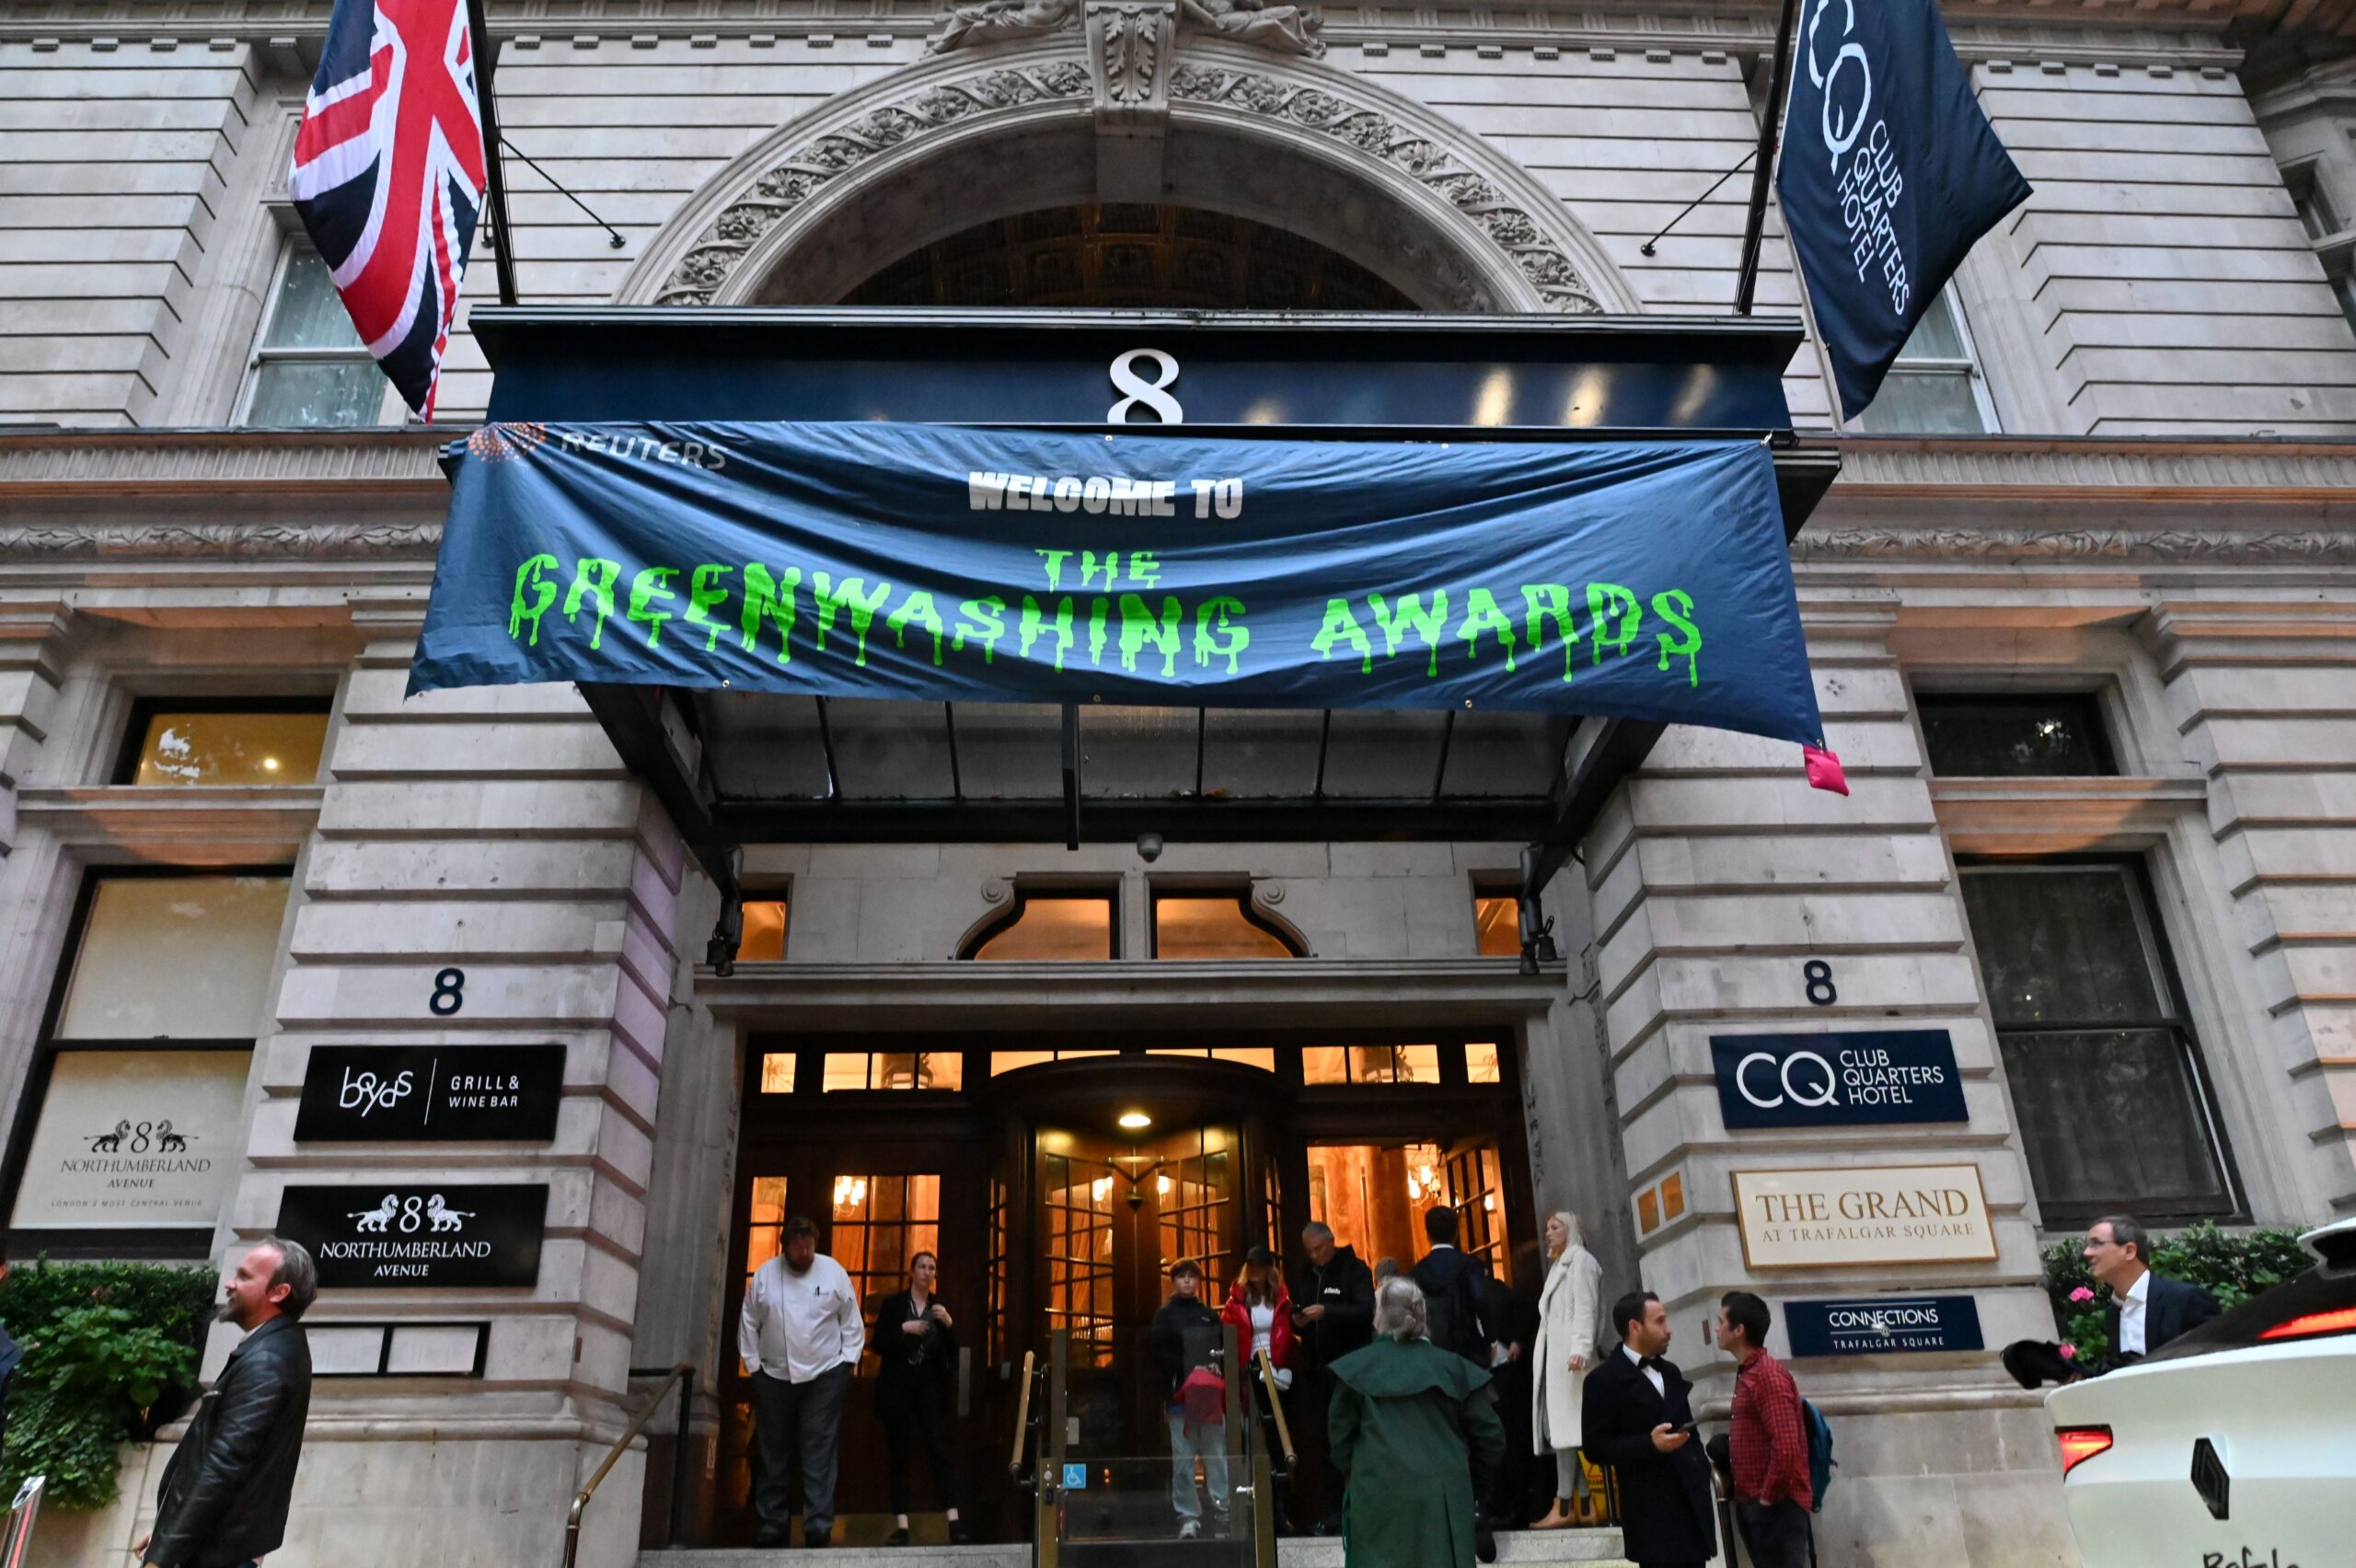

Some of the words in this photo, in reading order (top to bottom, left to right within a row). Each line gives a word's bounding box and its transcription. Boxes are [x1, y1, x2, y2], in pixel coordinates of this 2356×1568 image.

[1869, 120, 1903, 208] CLUB
[1838, 168, 1875, 282] HOTEL
[1854, 147, 1910, 316] QUARTERS
[1107, 348, 1183, 423] 8
[560, 432, 728, 469] REUTERS
[968, 472, 1175, 516] WELCOME
[1191, 478, 1242, 519] TO
[1034, 549, 1161, 594] THE
[509, 554, 1250, 678] GREENWASHING
[1311, 582, 1702, 687] AWARDS
[429, 968, 465, 1015] 8
[1803, 960, 1837, 1006] 8
[1840, 1049, 1889, 1067] CLUB
[340, 1066, 413, 1117] boyds
[451, 1076, 503, 1090] GRILL
[509, 1076, 519, 1090] &
[1736, 1051, 1840, 1108] CQ
[1842, 1066, 1945, 1087] QUARTERS
[449, 1096, 486, 1108] WINE
[490, 1096, 518, 1107] BAR
[1848, 1086, 1913, 1105] HOTEL
[131, 1121, 152, 1153] 8
[61, 1159, 211, 1172] NORTHUMBERLAND
[107, 1178, 155, 1189] AVENUE
[399, 1196, 422, 1233] 8
[1755, 1193, 1830, 1222] THE
[1839, 1189, 1969, 1220] GRAND
[1762, 1228, 1782, 1242] AT
[1789, 1226, 1896, 1241] TRAFALGAR
[1904, 1223, 1975, 1238] SQUARE
[320, 1241, 491, 1259] NORTHUMBERLAND
[374, 1264, 429, 1277] AVENUE
[1829, 1309, 1939, 1327] CONNECTIONS
[1833, 1338, 1897, 1350] TRAFALGAR
[1902, 1336, 1944, 1347] SQUARE
